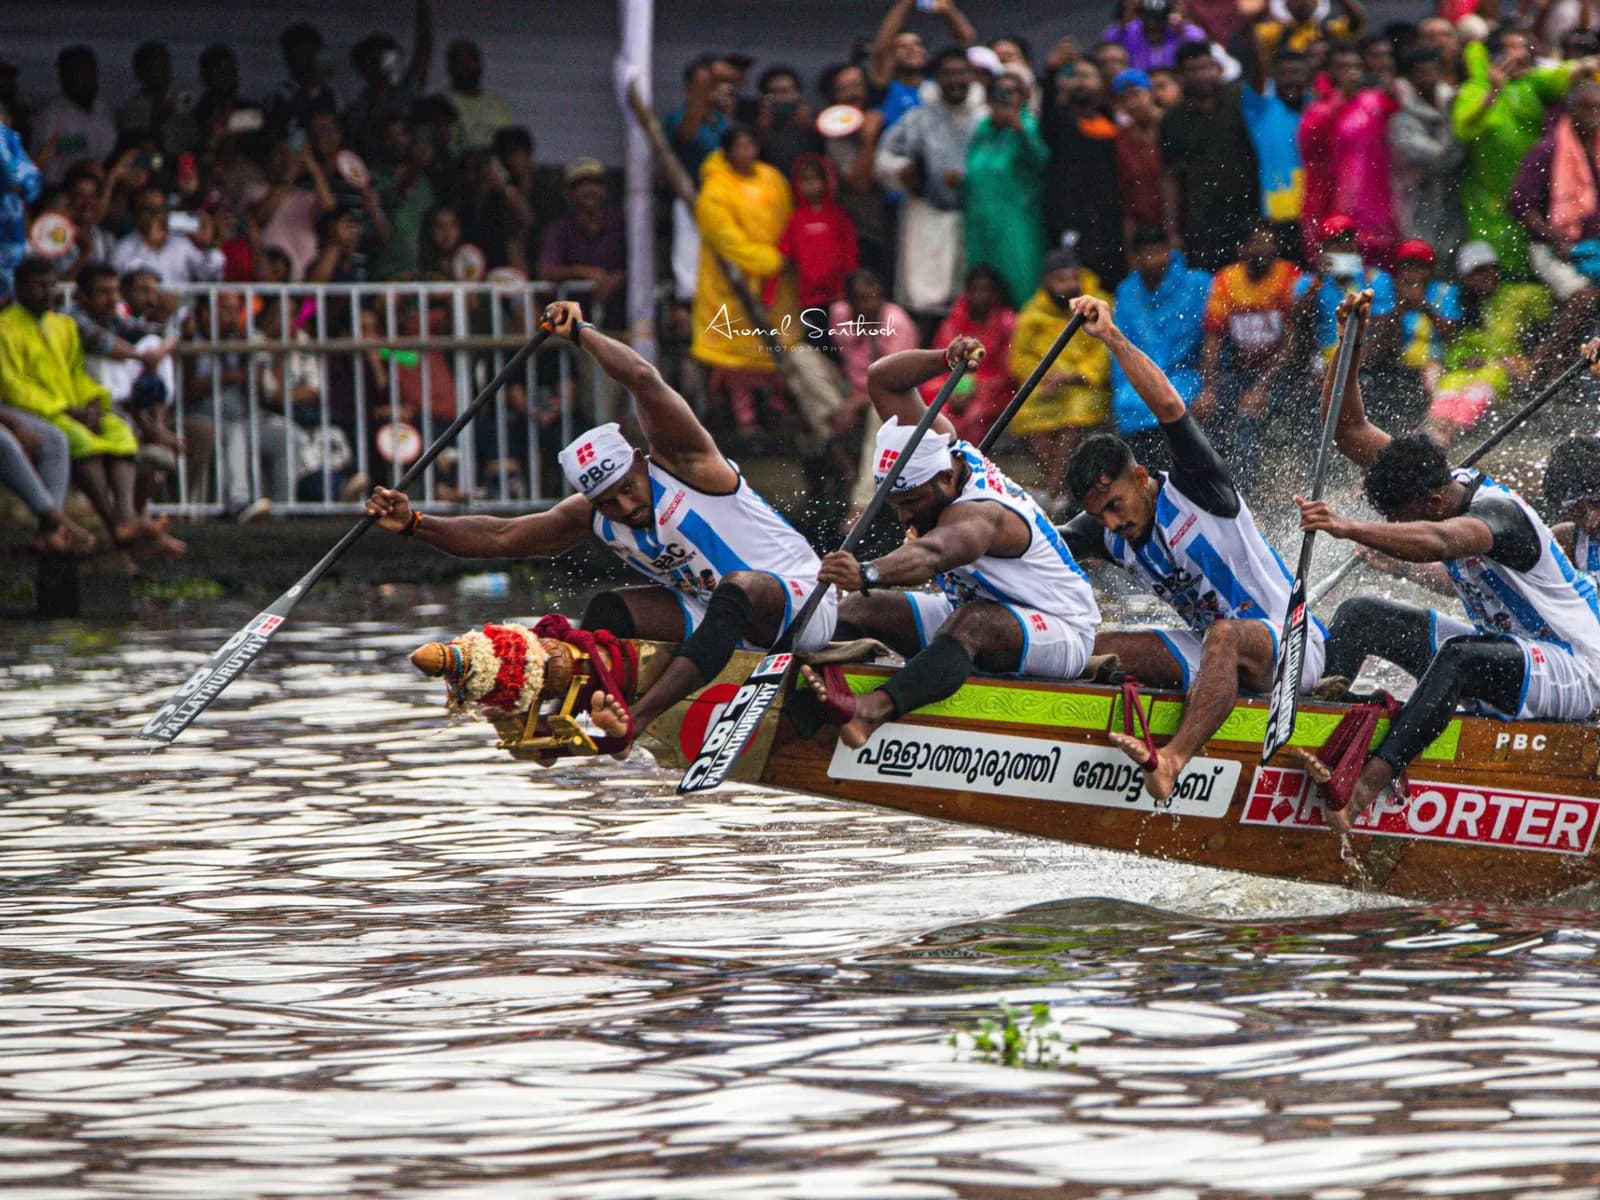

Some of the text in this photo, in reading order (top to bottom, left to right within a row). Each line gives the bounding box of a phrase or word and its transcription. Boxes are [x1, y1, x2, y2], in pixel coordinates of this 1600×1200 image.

[579, 459, 615, 488] PBC
[158, 633, 268, 738] PALLATHURUTHY
[701, 683, 779, 787] PALLATHURUTHY
[1495, 733, 1547, 751] PBC
[857, 738, 1061, 787] പള്ളാത്തുരുത്തി
[1073, 760, 1145, 802] ബോട്ട
[1299, 778, 1587, 848] RPORTER
